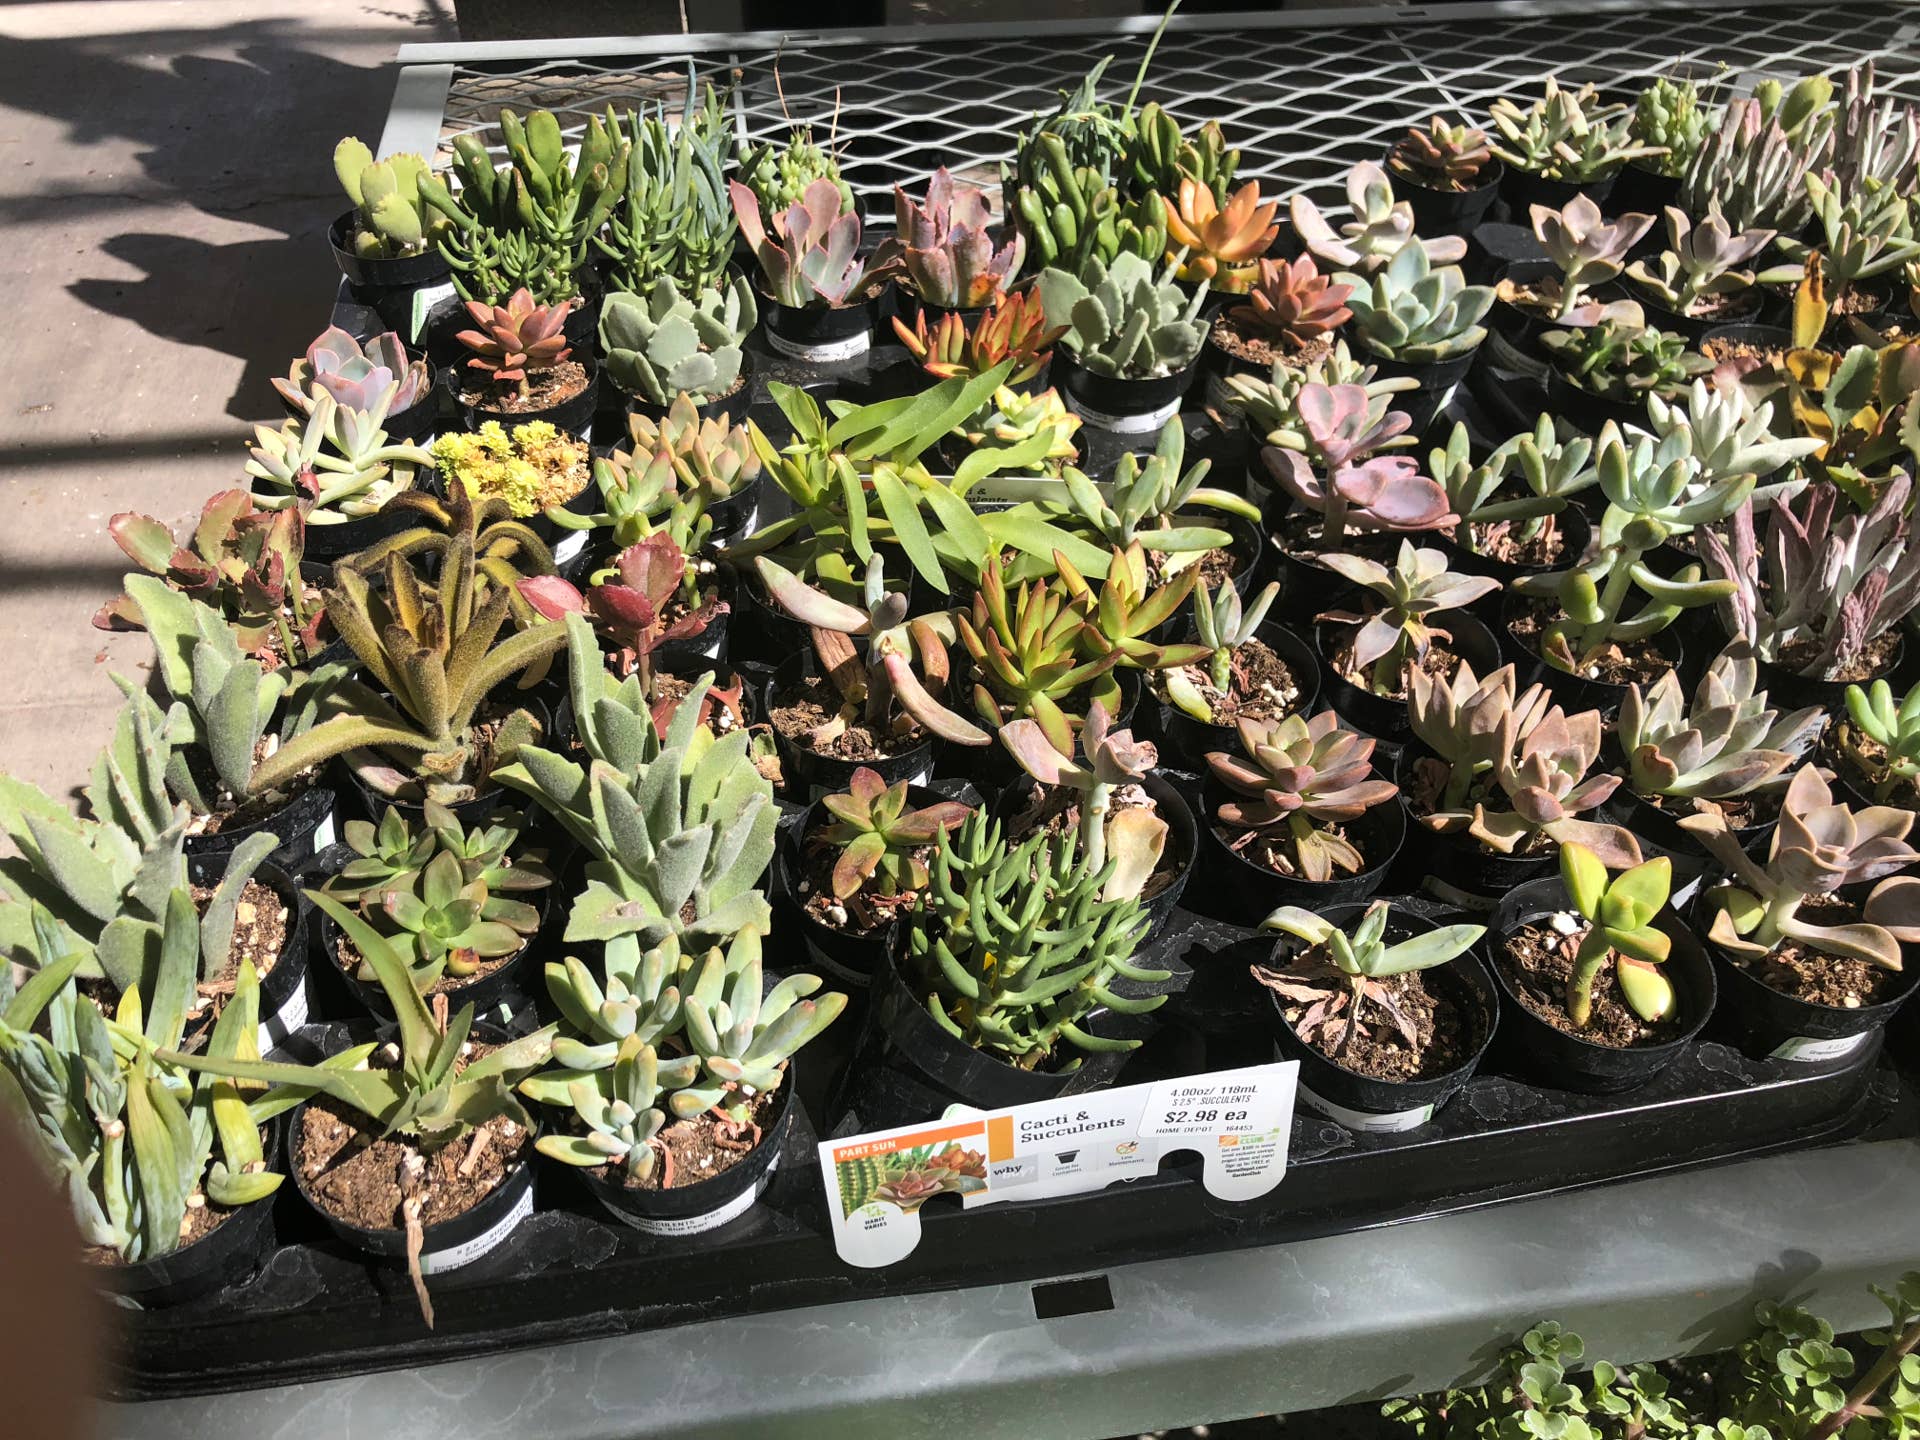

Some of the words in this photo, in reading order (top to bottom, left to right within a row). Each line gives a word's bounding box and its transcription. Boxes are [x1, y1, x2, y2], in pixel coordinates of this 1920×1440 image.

[1170, 1087, 1215, 1097] 4.00oz/
[1220, 1085, 1258, 1095] 118mL
[1020, 1114, 1068, 1131] Cacti
[1076, 1111, 1089, 1121] &
[1164, 1110, 1218, 1124] $2.98
[1225, 1110, 1248, 1121] ea
[1021, 1118, 1126, 1143] Succulents
[839, 1145, 869, 1159] PART
[872, 1140, 896, 1152] SUN
[993, 1164, 1023, 1176] why
